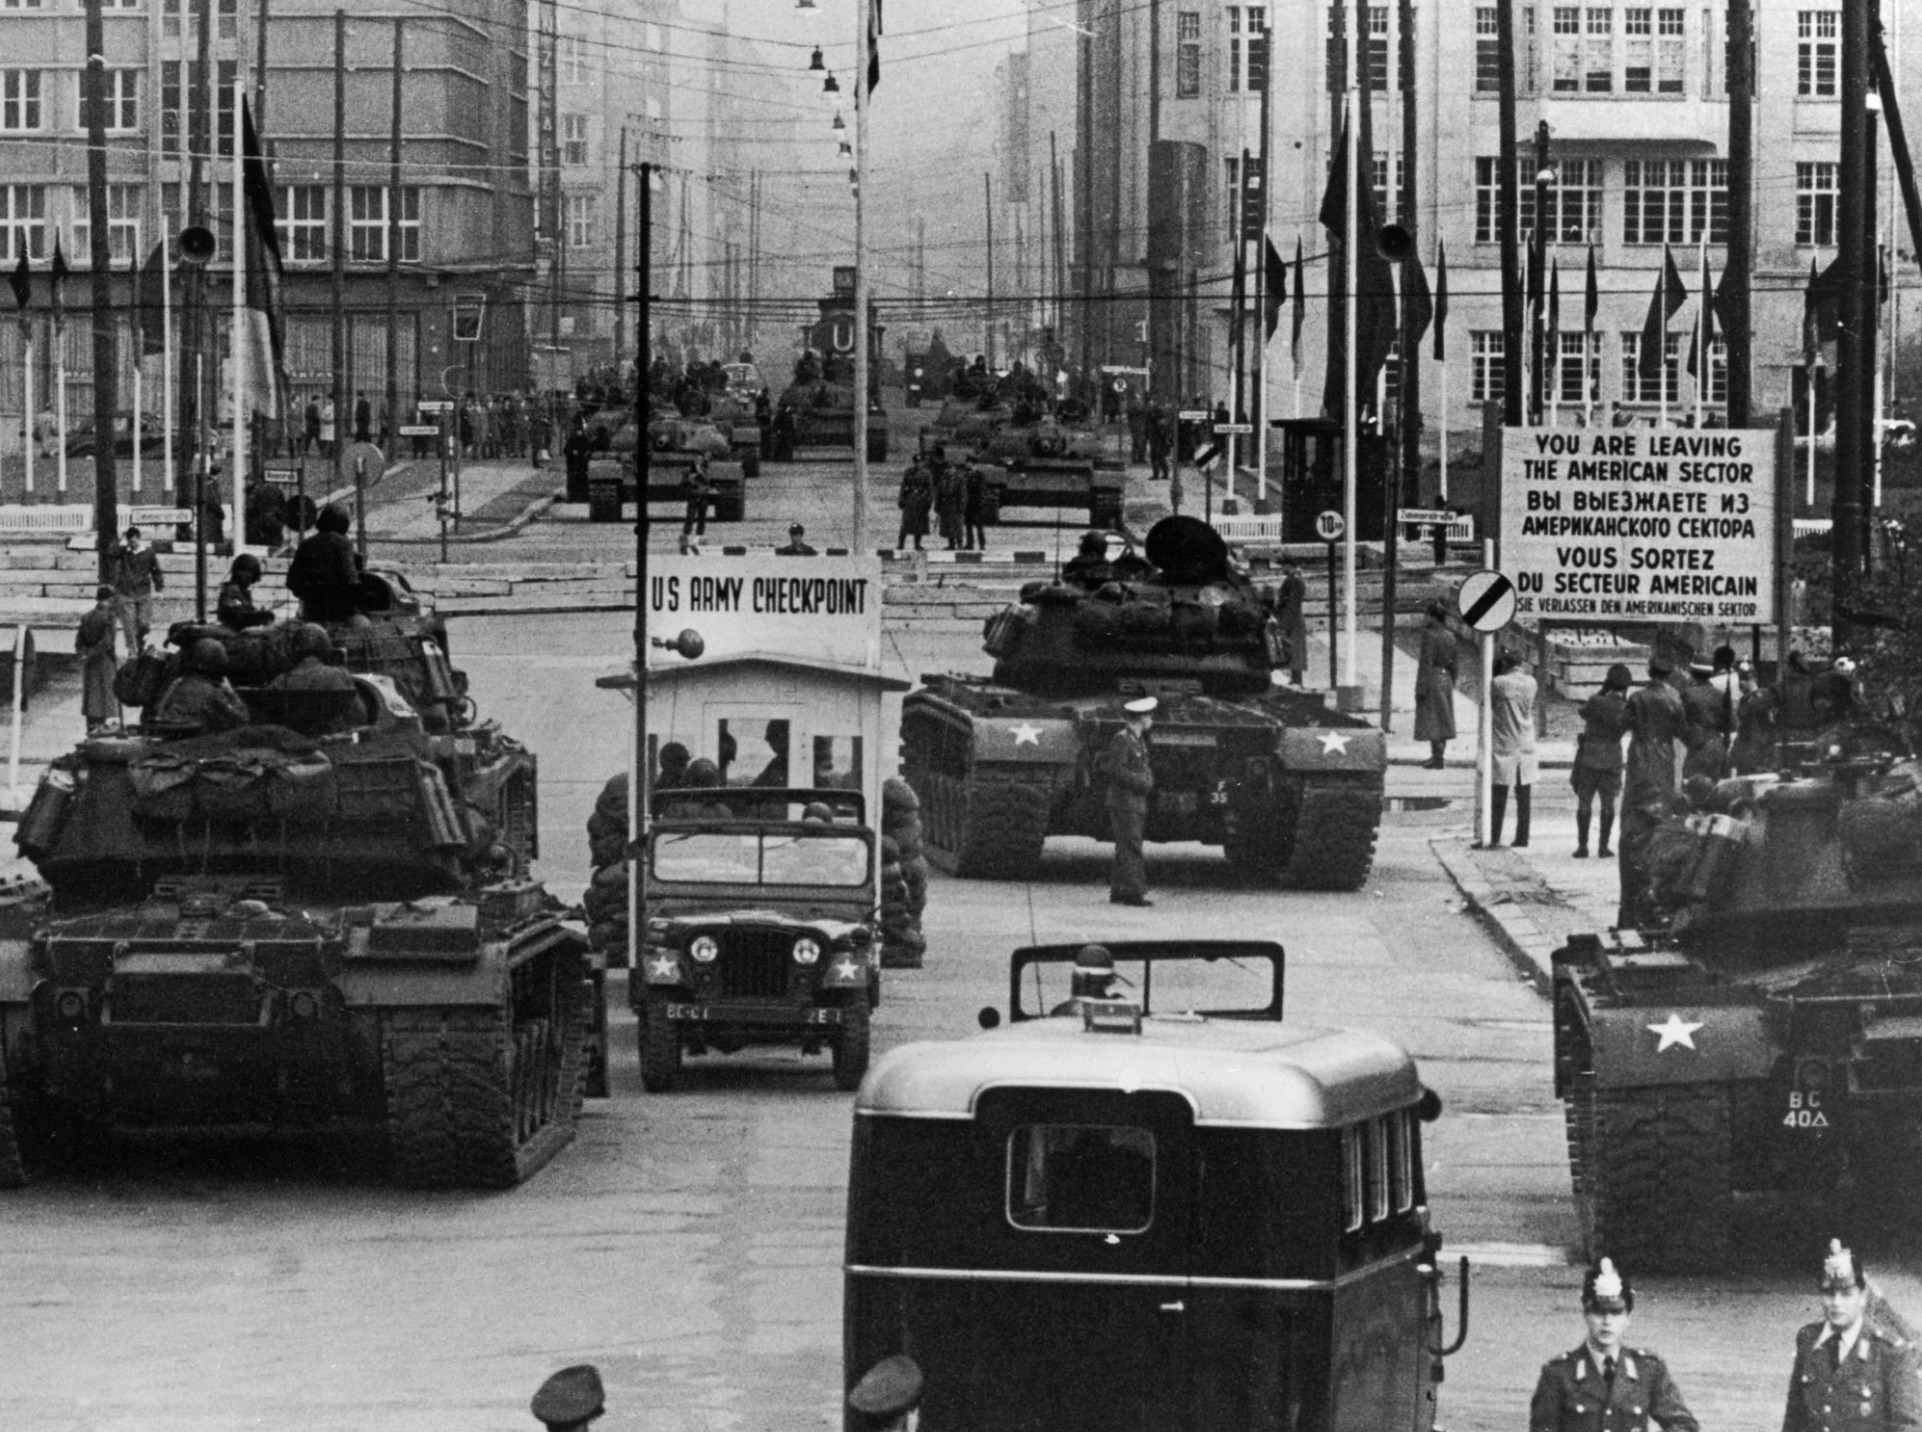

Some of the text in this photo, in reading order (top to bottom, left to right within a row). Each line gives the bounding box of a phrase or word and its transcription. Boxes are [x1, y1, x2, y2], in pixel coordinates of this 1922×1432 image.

[833, 323, 853, 351] U
[1535, 434, 1742, 457] YOU ARE LEAVING
[1524, 459, 1753, 483] THE AMERICAN SECTOR
[1527, 490, 1750, 514] ВЫ ВЫЕЗЖАЕТЕ ИЗ
[1320, 514, 1335, 534] 10
[1522, 516, 1756, 539] АМЕРИКАНСКОГО СЕКТОРА
[1557, 547, 1715, 570] VOUS SORTEZ
[652, 576, 868, 614] US ARMY CHECKPOINT
[1518, 572, 1757, 596] DU SECTEUR AMERICAIN
[1517, 597, 1757, 617] SIE VERLASSEN DEN AMERIKANISCHEN SEKTOR
